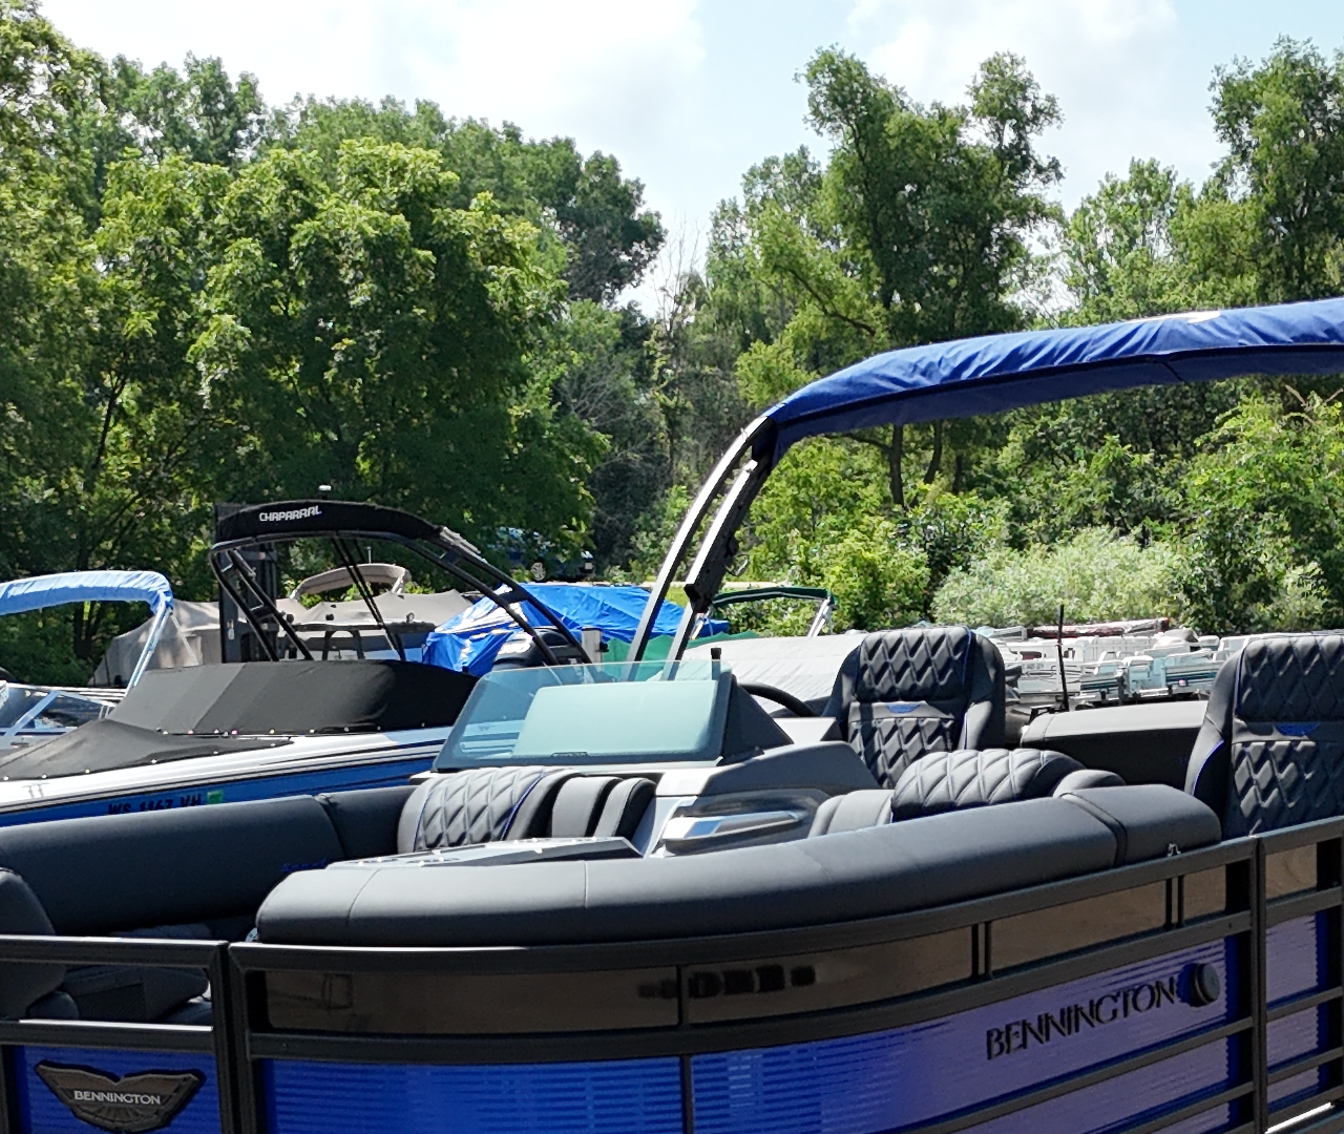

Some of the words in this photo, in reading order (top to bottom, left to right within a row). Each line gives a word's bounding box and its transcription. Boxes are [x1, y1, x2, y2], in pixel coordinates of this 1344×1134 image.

[259, 505, 322, 521] CHAPARRAL
[986, 976, 1175, 1060] BENNINGTON
[74, 1090, 161, 1105] BENNINGTON
